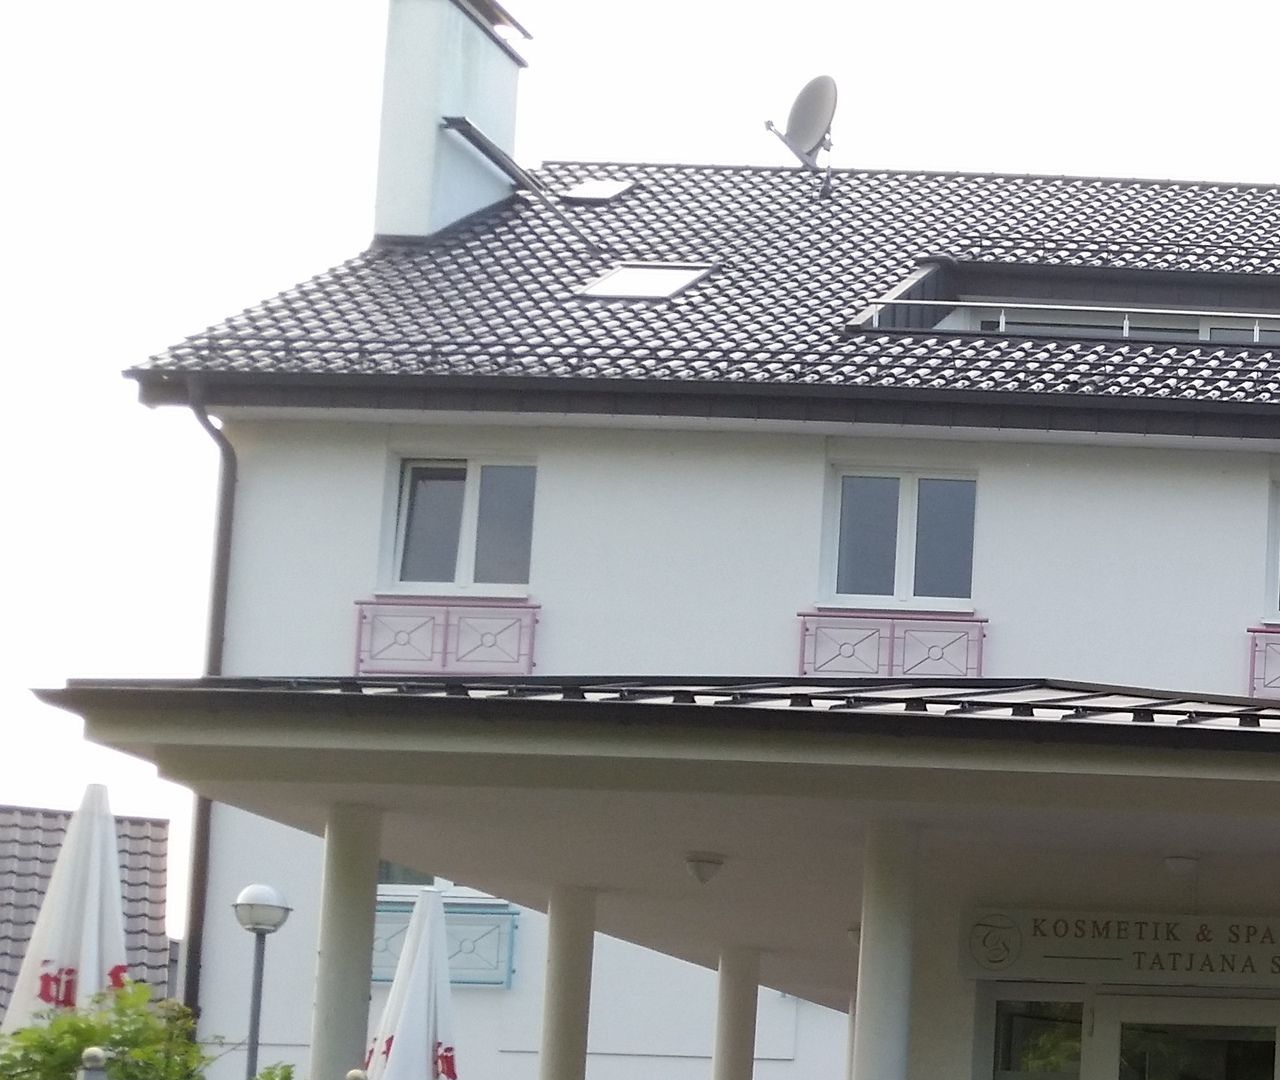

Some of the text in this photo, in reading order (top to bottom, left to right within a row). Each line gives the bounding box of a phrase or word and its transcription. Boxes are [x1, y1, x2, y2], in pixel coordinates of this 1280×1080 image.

[1032, 918, 1276, 944] KOSMETIK & SPA
[1132, 951, 1256, 974] TATJANA
